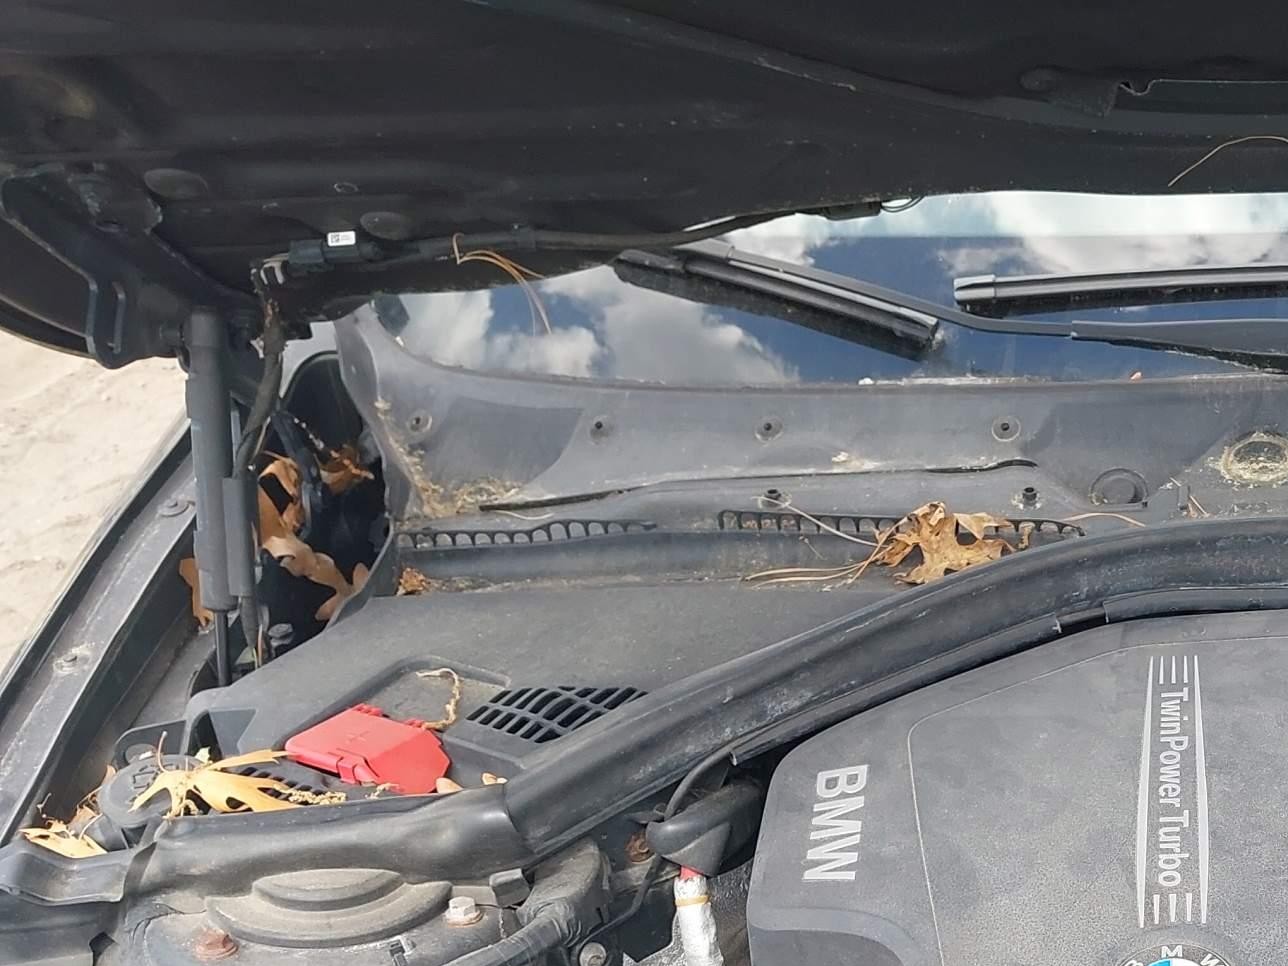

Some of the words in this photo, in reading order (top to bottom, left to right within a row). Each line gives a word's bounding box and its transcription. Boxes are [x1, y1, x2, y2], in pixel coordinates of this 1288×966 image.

[1159, 687, 1189, 808] TwinPower
[801, 764, 868, 880] BMW
[1158, 809, 1190, 887] Turbo
